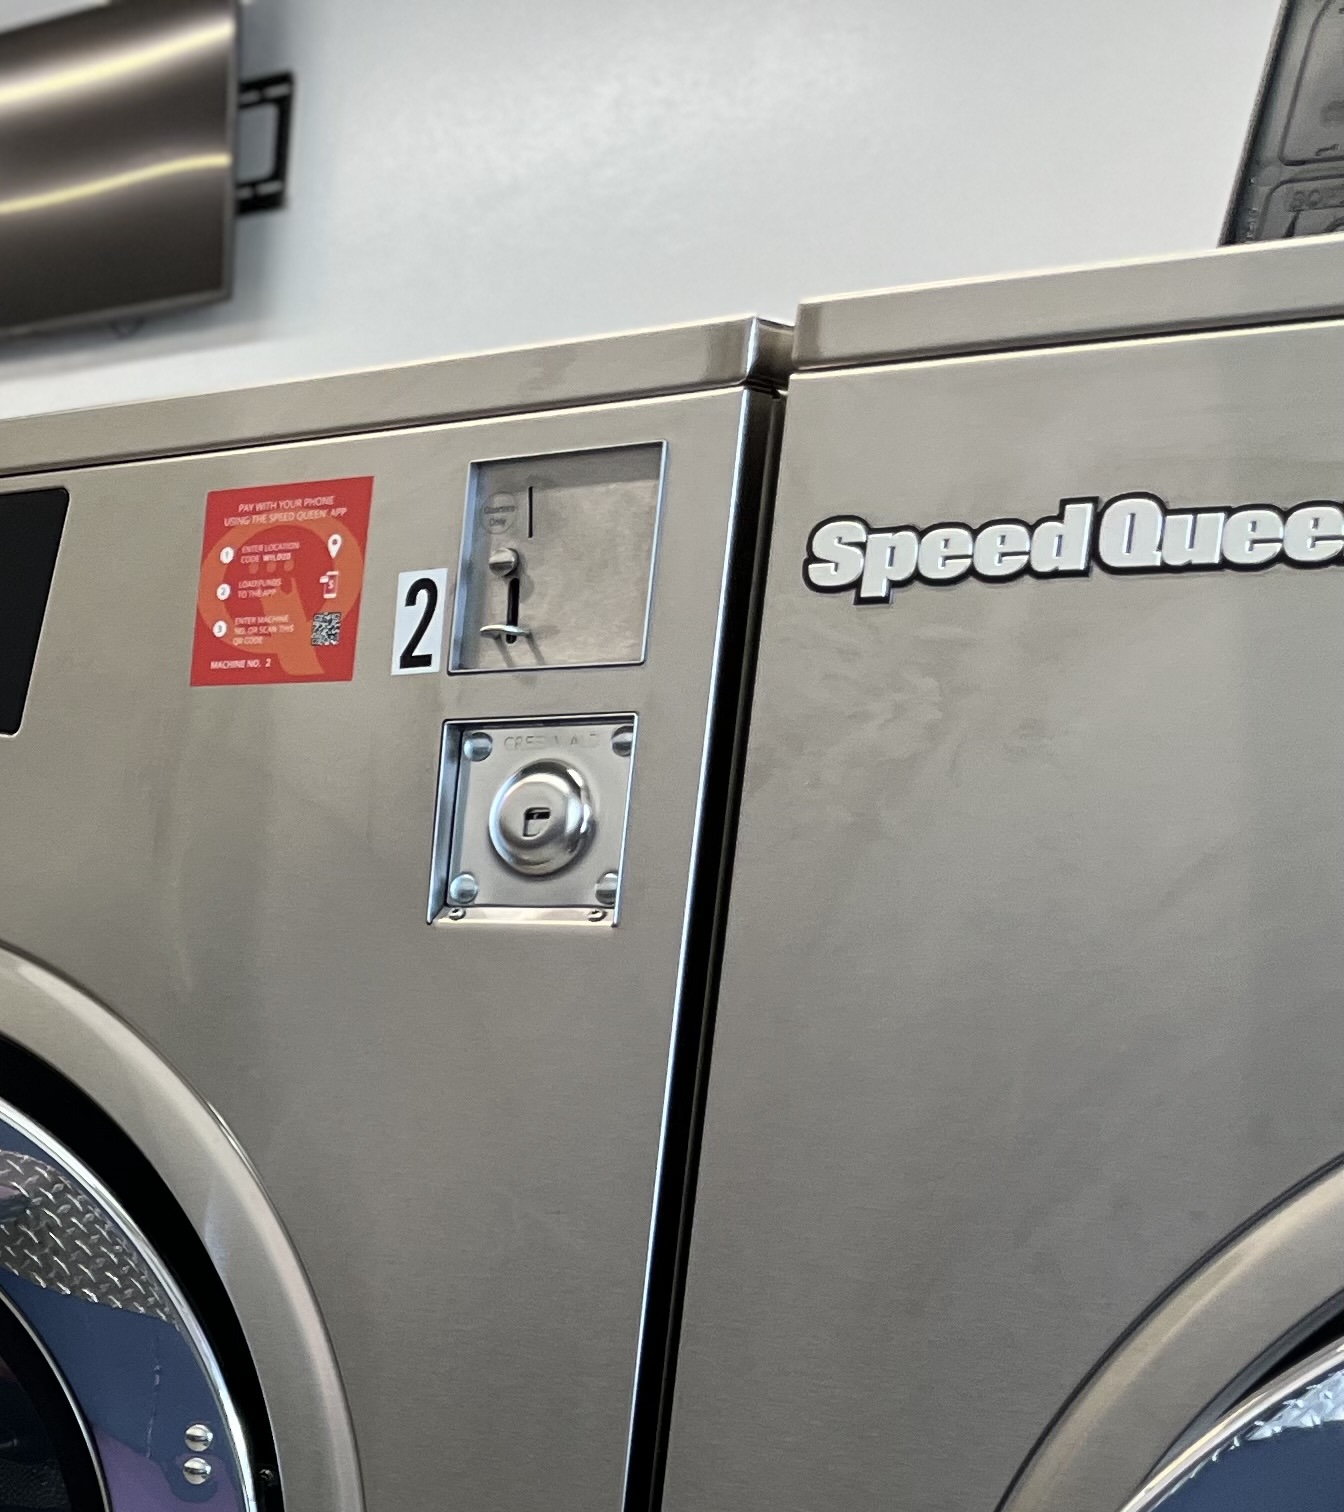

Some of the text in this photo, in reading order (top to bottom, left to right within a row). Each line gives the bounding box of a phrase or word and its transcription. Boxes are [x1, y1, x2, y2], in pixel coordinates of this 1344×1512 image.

[238, 495, 335, 513] PAY WITH YOUR PHONE
[224, 515, 250, 527] USING
[252, 513, 267, 524] THE
[269, 511, 294, 523] SPEED
[330, 507, 347, 517] APP
[242, 541, 300, 554] ENTER LOCATION
[803, 492, 1344, 605] Speed Quee
[240, 554, 259, 564] CODE
[238, 578, 282, 589] LOAD FUNDS
[238, 589, 248, 599] TO
[249, 588, 261, 598] THE
[234, 615, 289, 626] ENTER MACHINE
[400, 577, 438, 669] 2
[247, 625, 258, 634] OR
[259, 624, 277, 634] SCAN
[278, 624, 294, 633] THIS
[232, 635, 263, 647] QR CODE
[210, 658, 272, 670] MACHINE NO. 2
